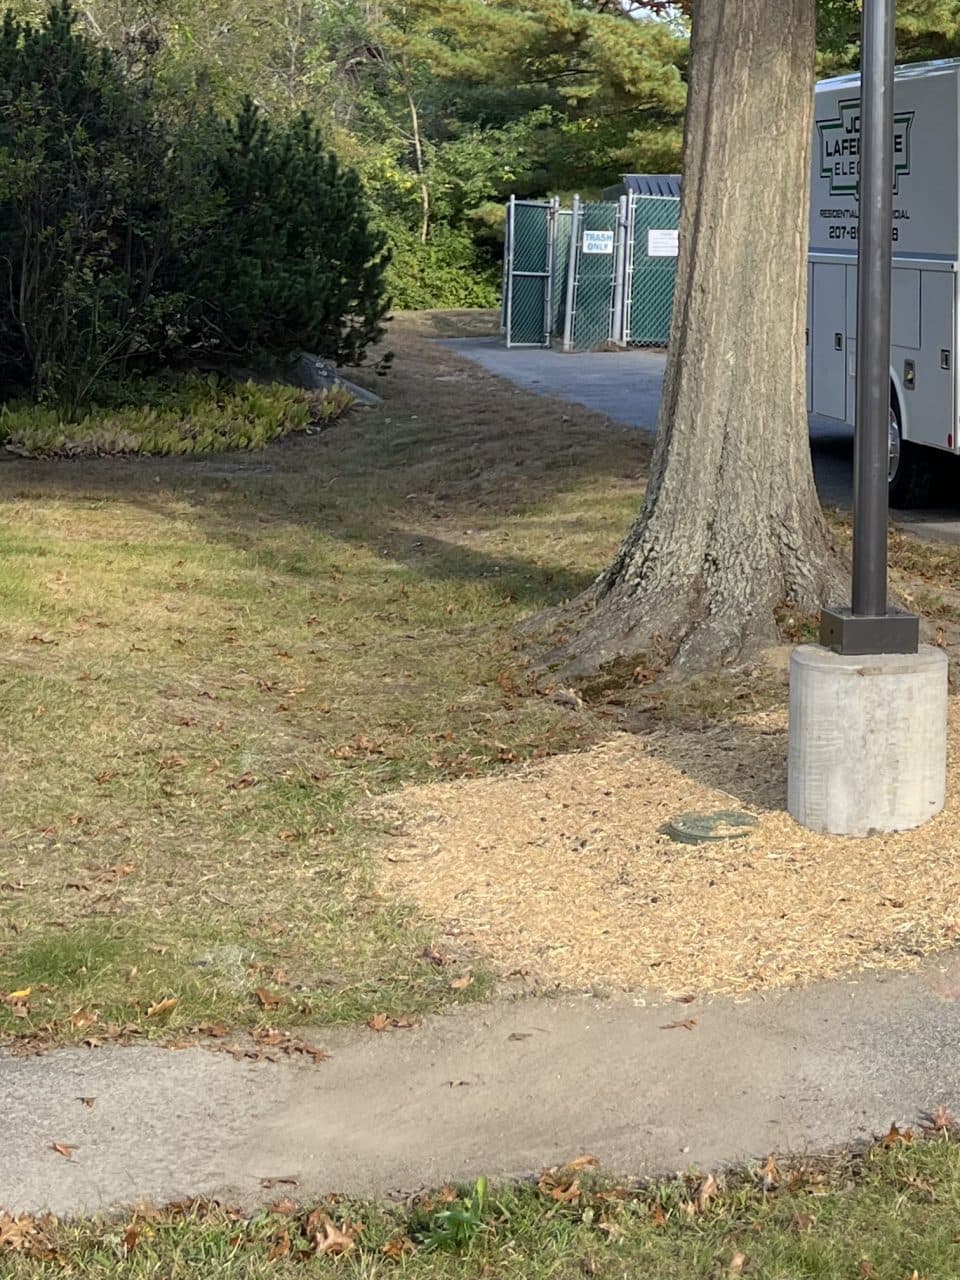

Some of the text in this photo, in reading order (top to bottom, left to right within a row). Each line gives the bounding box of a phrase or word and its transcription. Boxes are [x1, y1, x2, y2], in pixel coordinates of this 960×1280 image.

[825, 135, 903, 157] LAFEE
[585, 233, 612, 242] TRASH
[587, 242, 609, 251] ONLY
